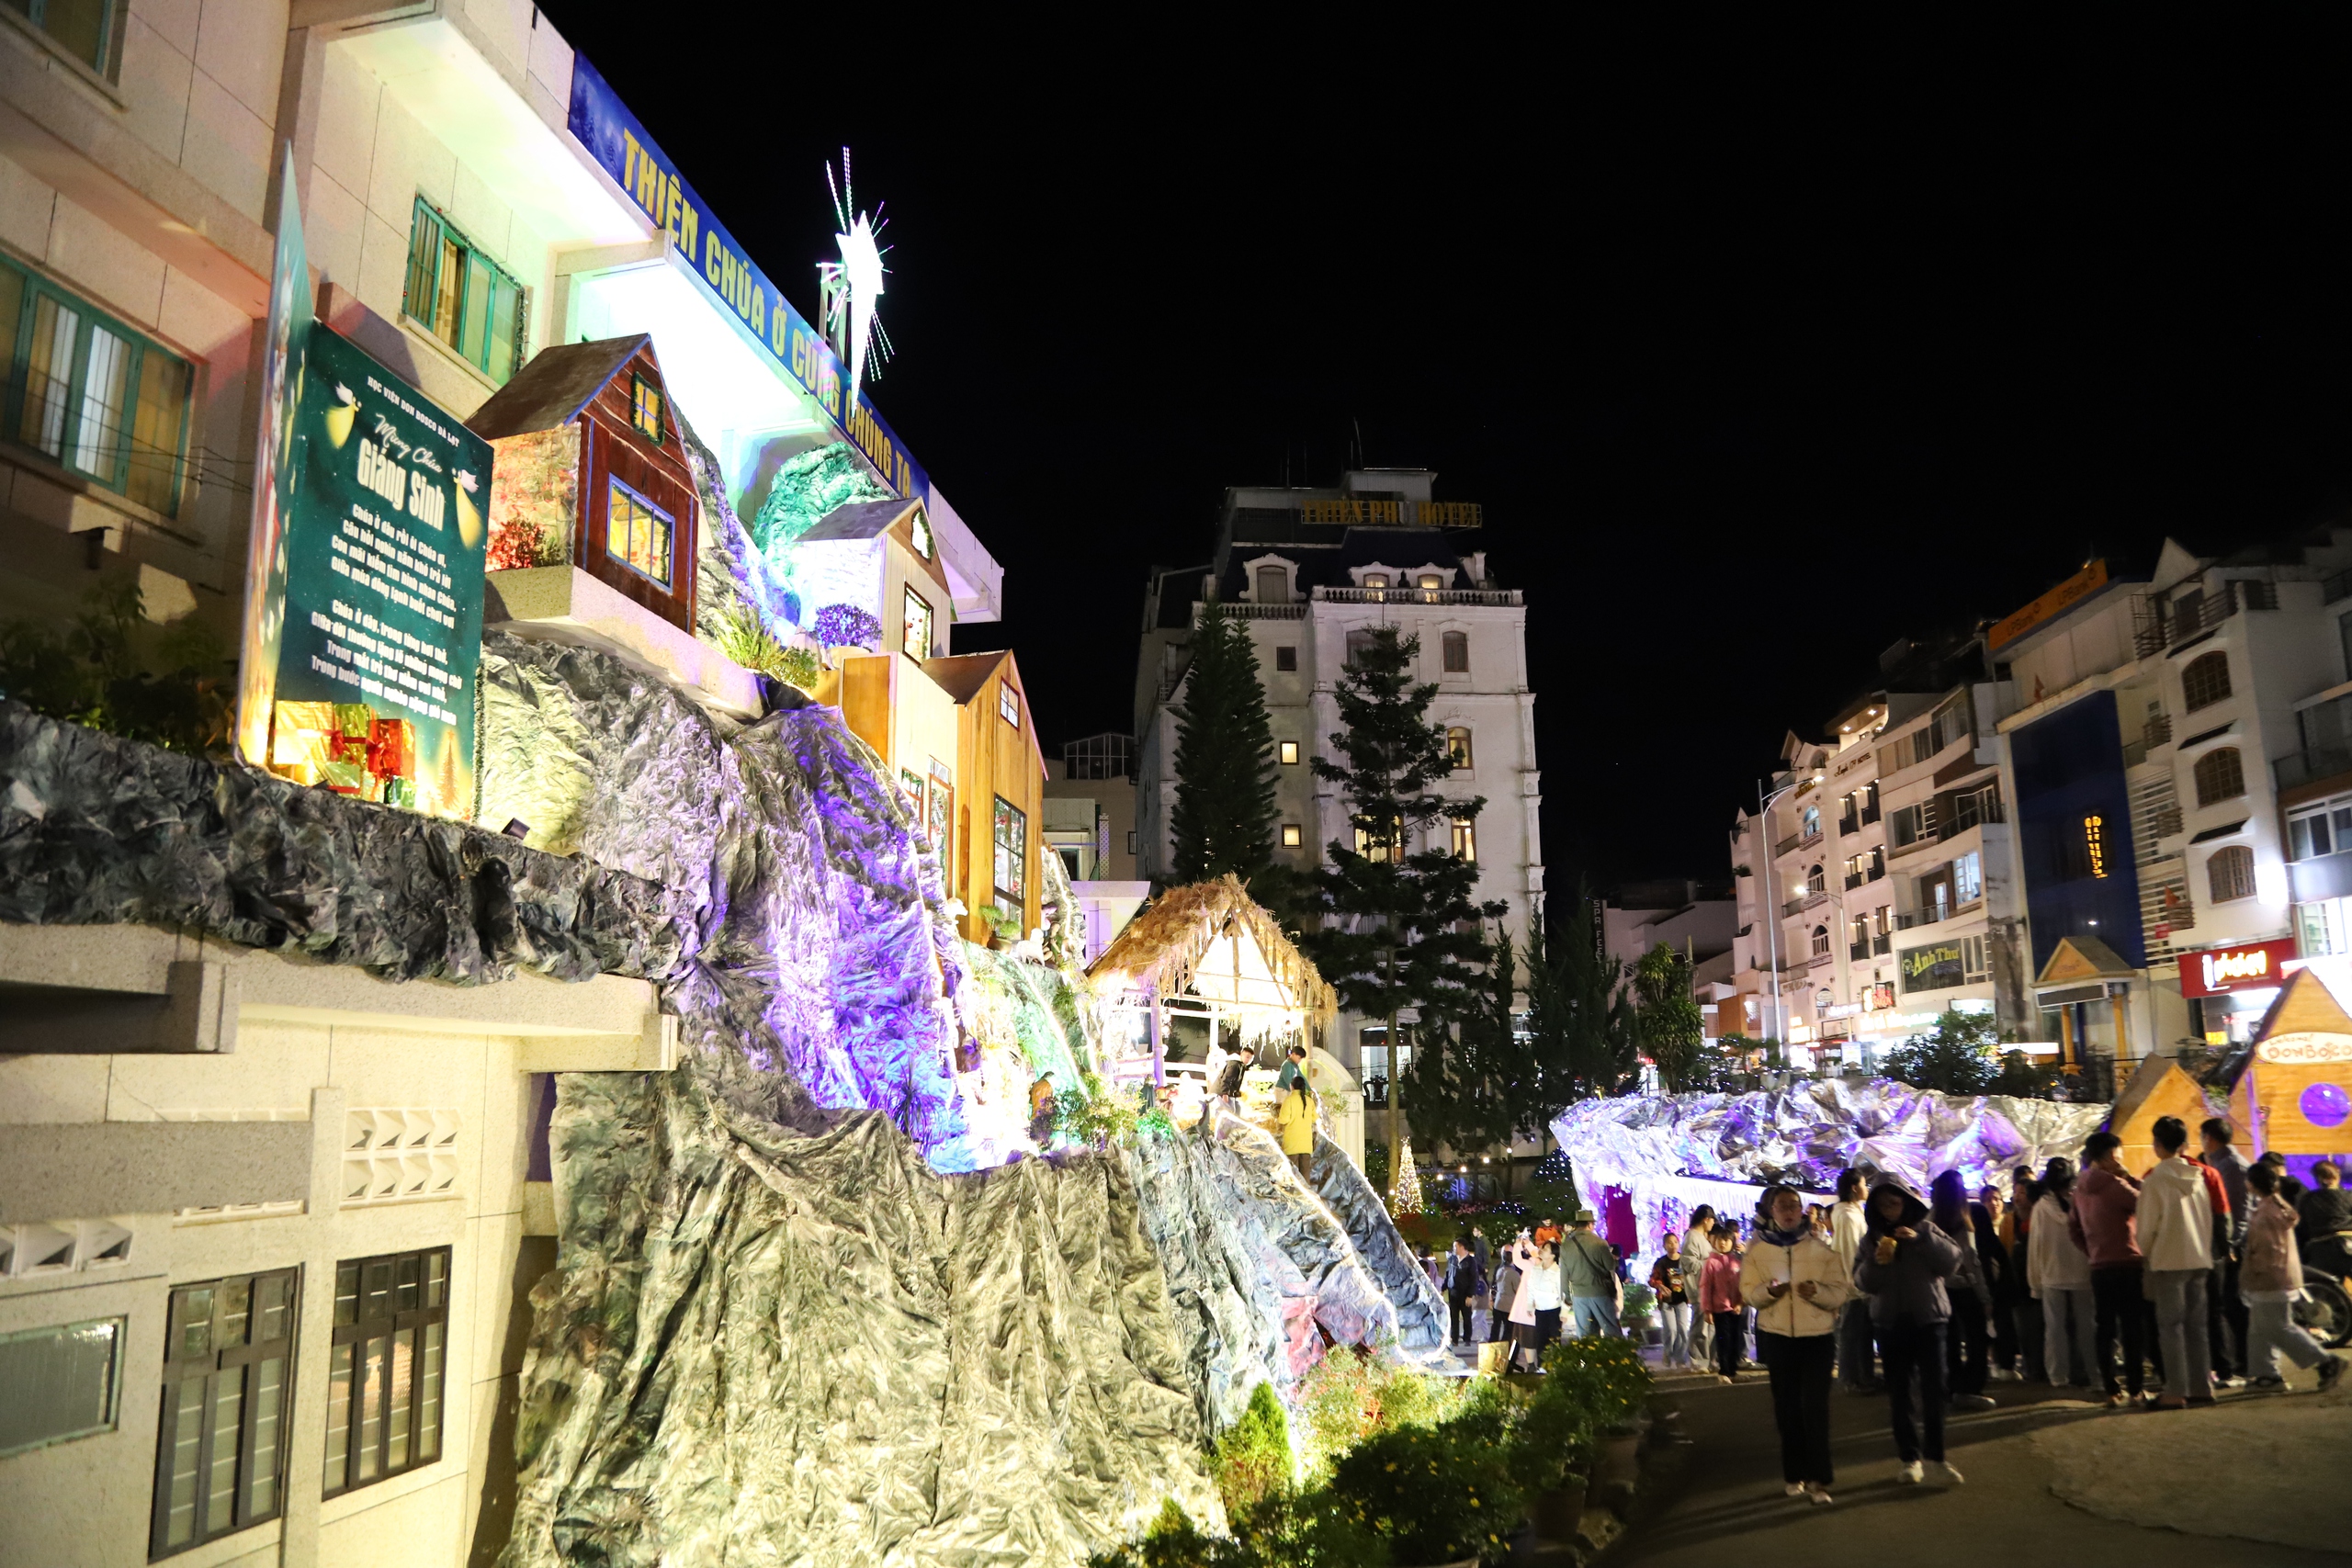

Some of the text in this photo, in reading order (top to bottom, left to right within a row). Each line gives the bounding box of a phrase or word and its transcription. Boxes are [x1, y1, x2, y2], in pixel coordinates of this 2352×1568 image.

[624, 127, 910, 498] THIÊN CHÚA Ở CÙNG CHÚNG TA
[368, 376, 459, 447] HỌC VIỆN DON BOSCO ĐÀ LẠT
[375, 412, 442, 473] Mừng Chúa
[357, 438, 445, 531] Giáng Sinh
[353, 503, 373, 526] Chúa
[374, 511, 380, 529] ở
[380, 521, 395, 538] đâu
[396, 528, 409, 546] rồi
[418, 541, 436, 562] Chúa
[1418, 502, 1483, 528] HOTEL
[332, 535, 348, 554] Con
[349, 545, 366, 563] mãi
[367, 552, 386, 574] kiếm
[387, 564, 401, 581] tìm
[436, 591, 457, 612] Chúa,
[343, 519, 359, 539] Câu
[360, 528, 374, 547] hỏi
[397, 550, 413, 569] năm
[414, 558, 428, 577] khó
[429, 567, 441, 583] trả
[441, 573, 451, 589] lời
[331, 556, 455, 629] Giữa mùa đông lạnh buốt chơi vơi
[2007, 581, 2090, 637] LPBank LPBank
[311, 611, 332, 632] Giữa
[332, 622, 346, 638] đời
[347, 627, 377, 653] thường
[378, 639, 394, 661] lặng
[448, 674, 462, 690] chờ
[327, 639, 352, 663] Trong
[353, 652, 369, 670] mắt
[332, 599, 354, 621] Chúa
[355, 608, 362, 624] ở
[380, 622, 402, 644] trong
[403, 632, 421, 652] từng
[421, 641, 434, 658] hơi
[311, 654, 337, 679] Trong
[337, 666, 360, 686] bước
[1593, 899, 1601, 924] SPA
[1913, 950, 1937, 977] Anh
[1936, 946, 1960, 962] Thư
